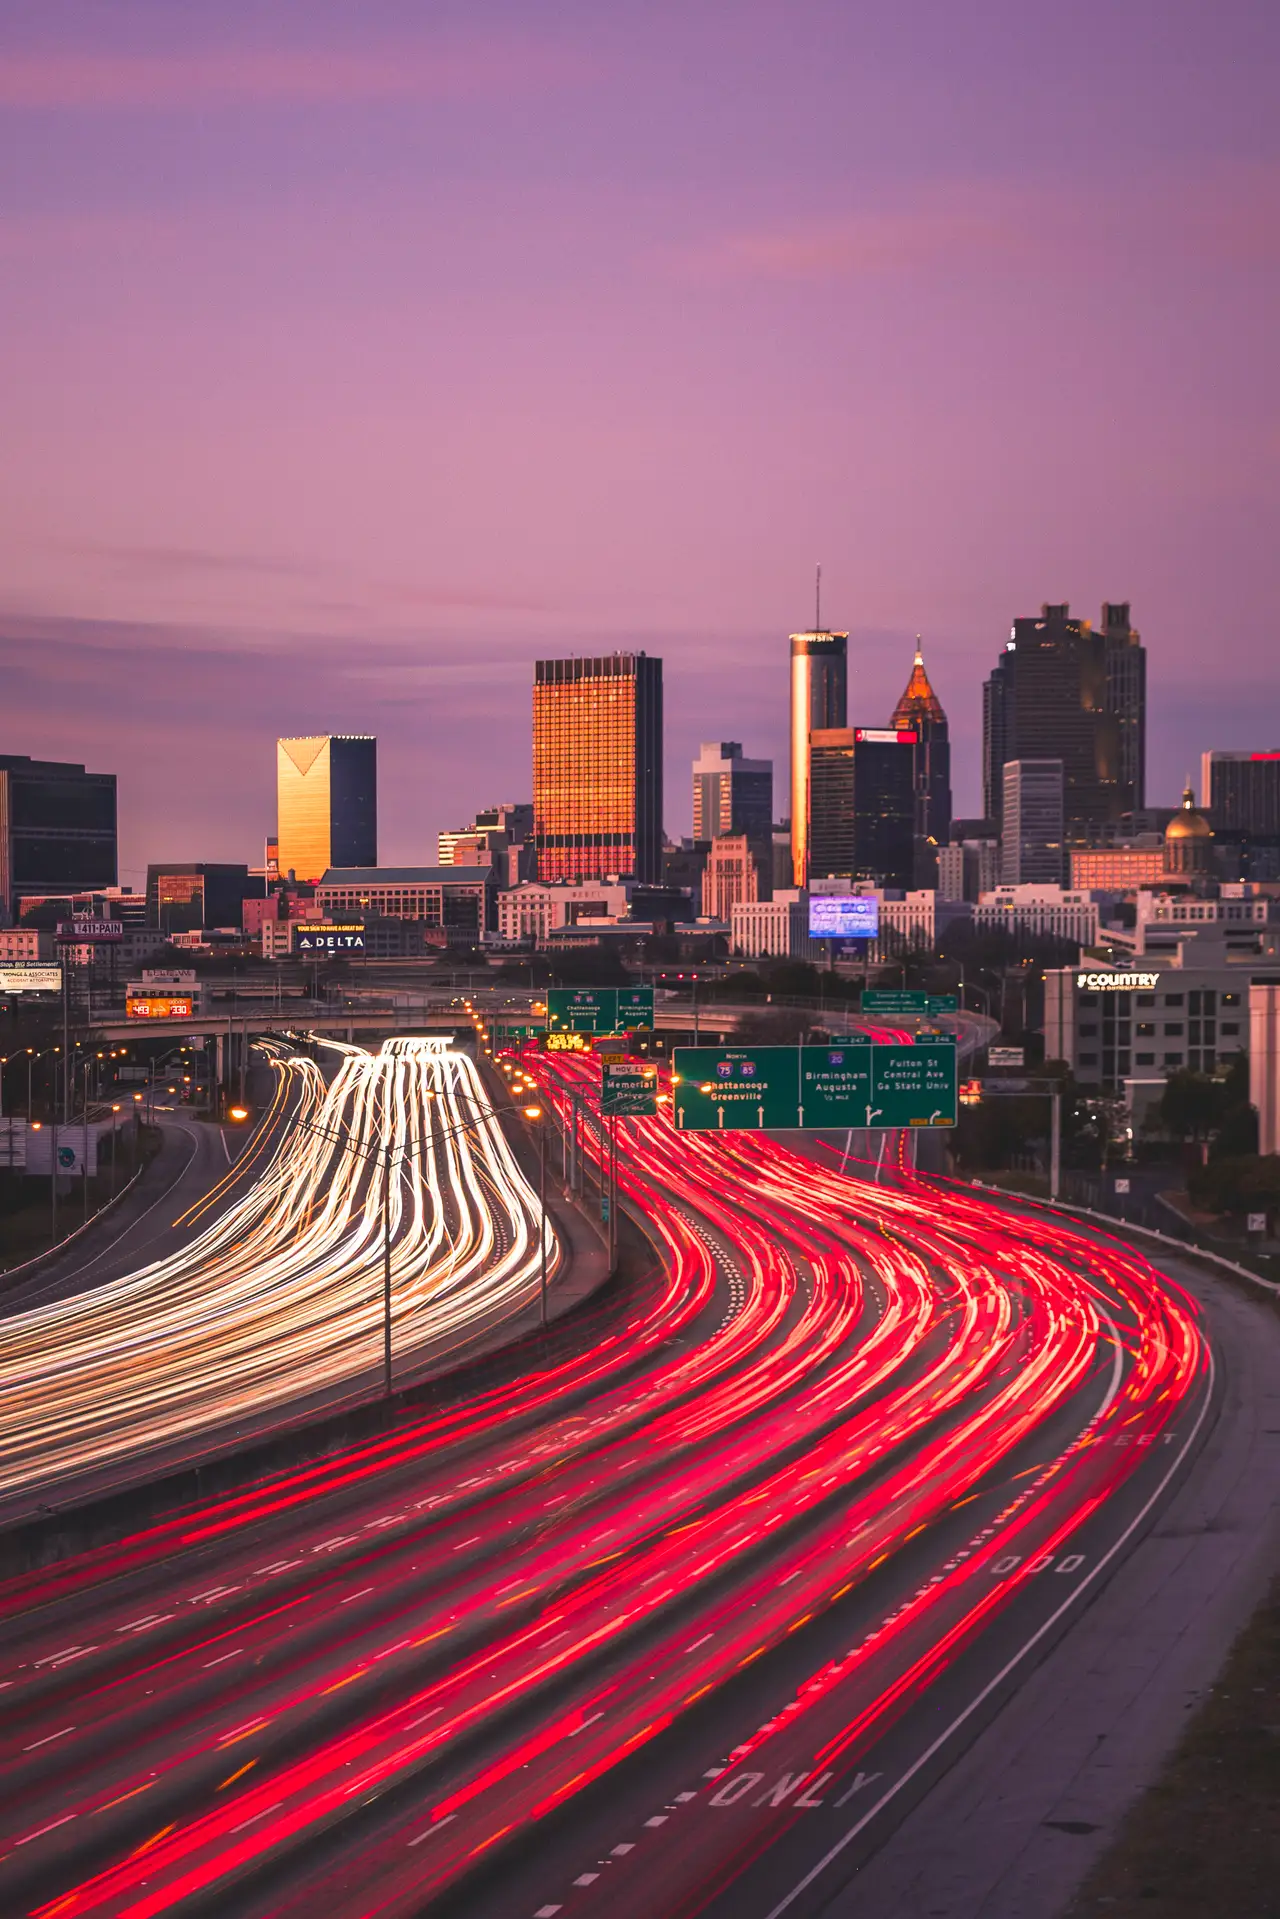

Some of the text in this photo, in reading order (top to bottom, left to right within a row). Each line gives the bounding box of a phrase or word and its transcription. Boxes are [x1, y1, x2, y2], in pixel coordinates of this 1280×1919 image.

[316, 936, 364, 947] DELTA
[1087, 973, 1160, 986] COUNTRY
[830, 1055, 843, 1064] 20
[889, 1059, 938, 1067] Fulton St
[720, 1066, 731, 1075] 75
[742, 1066, 754, 1075] 85
[883, 1071, 921, 1079] Central
[805, 1072, 868, 1081] Birmingham
[607, 1080, 653, 1088] Memorial
[815, 1083, 857, 1092] Augusta
[877, 1082, 949, 1090] Ga State Univ
[710, 1093, 762, 1101] Greenville
[708, 1772, 884, 1808] ONLY
